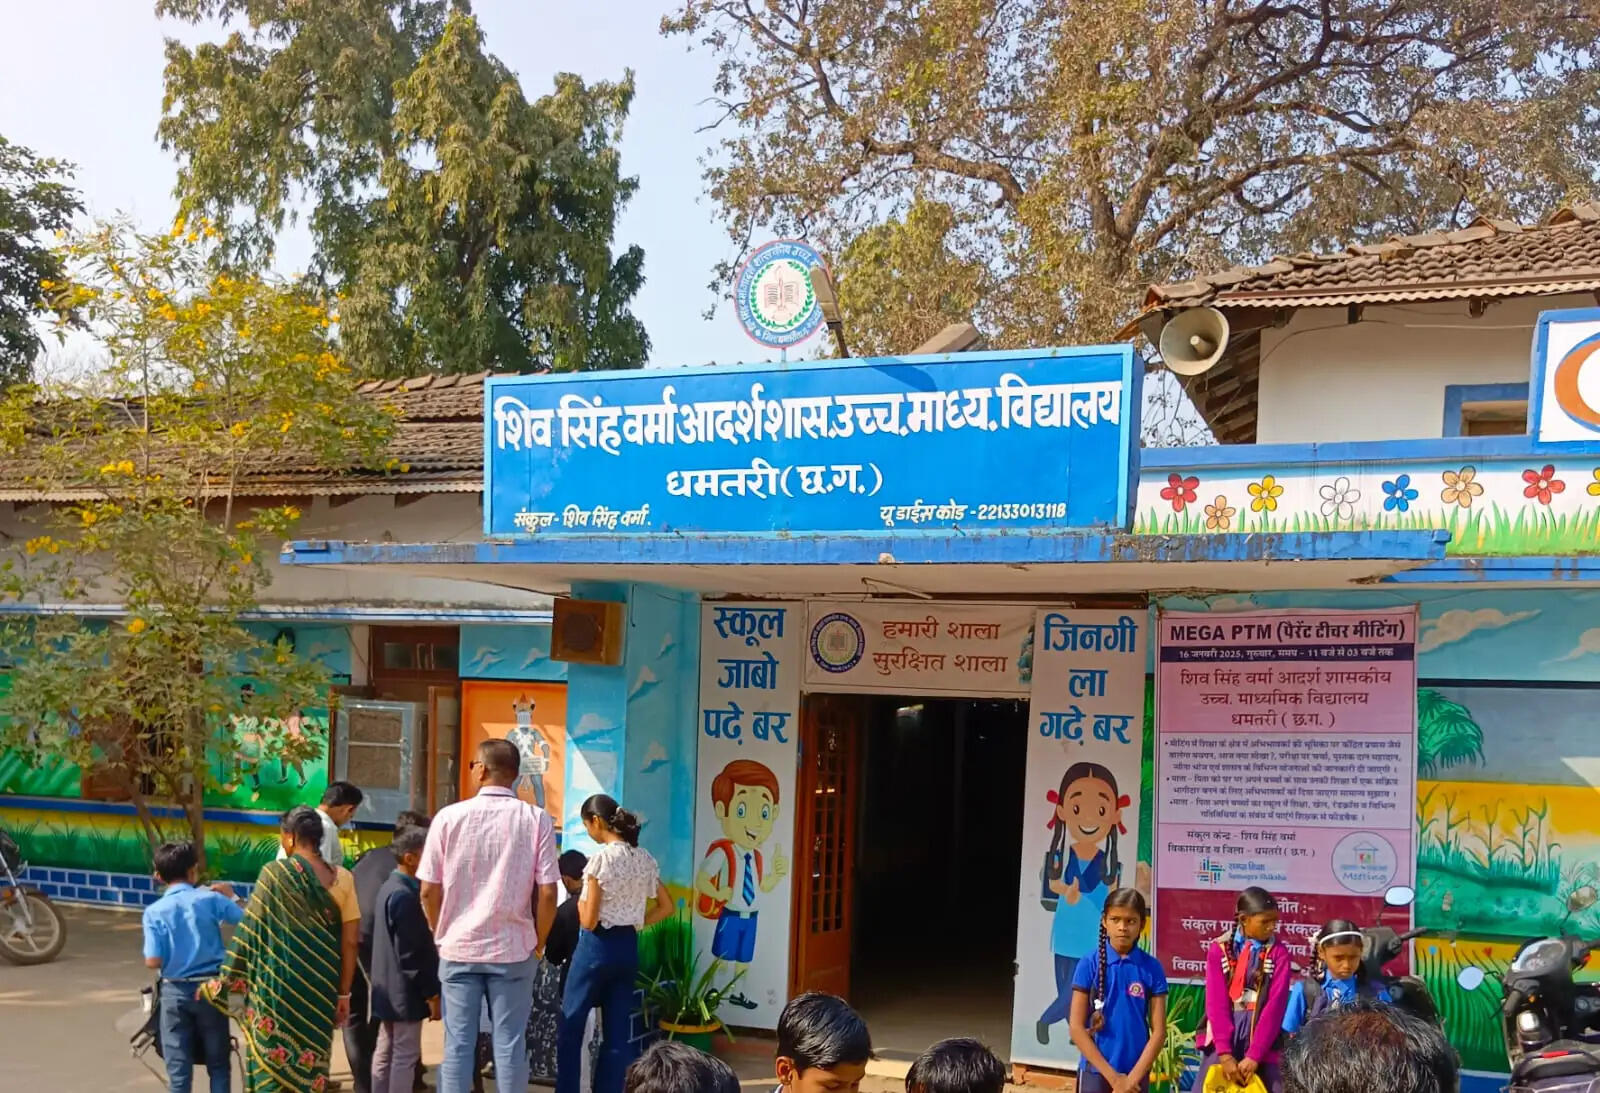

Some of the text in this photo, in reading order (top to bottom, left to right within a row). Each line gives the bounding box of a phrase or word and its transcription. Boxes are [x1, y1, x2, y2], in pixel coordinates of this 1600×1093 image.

[493, 395, 555, 451] शिव
[557, 393, 622, 456] सिंह
[623, 385, 678, 446] वर्मा
[677, 382, 765, 445] आदर्श
[995, 372, 1122, 429] विद्यालय
[562, 504, 590, 528] शिव
[592, 505, 620, 530] सिंह
[880, 506, 895, 526] यू
[936, 498, 968, 520] कोड
[713, 607, 786, 646] स्कूल
[882, 616, 1002, 640] हमारी शाला
[1043, 613, 1138, 652] जिनगी
[1171, 625, 1225, 641] MEGA
[1231, 624, 1272, 640] PTM
[1315, 621, 1349, 638] टीचर
[1352, 619, 1405, 641] मीटिंग)
[872, 646, 1008, 676] सुरक्षित शाला
[1180, 650, 1189, 658] 16
[1191, 648, 1218, 658] जनवरी
[1308, 648, 1318, 657] 11
[1346, 648, 1359, 656] 03
[717, 651, 779, 689] जाबो
[1180, 667, 1392, 686] शिव सिंह वर्मा आदर्श शासकीय
[1069, 669, 1109, 698] ला
[1237, 689, 1304, 705] माध्यमिक
[1307, 689, 1369, 705] विद्यालय
[753, 712, 791, 743] बर
[1093, 715, 1135, 744] बर
[1231, 709, 1278, 726] धमतरी
[1241, 830, 1258, 840] शिव
[1261, 830, 1277, 841] सिंह
[1279, 831, 1296, 841] वर्मा
[1222, 843, 1244, 855] जिला
[1255, 845, 1282, 856] धमतरी
[1181, 916, 1217, 934] संकुल
